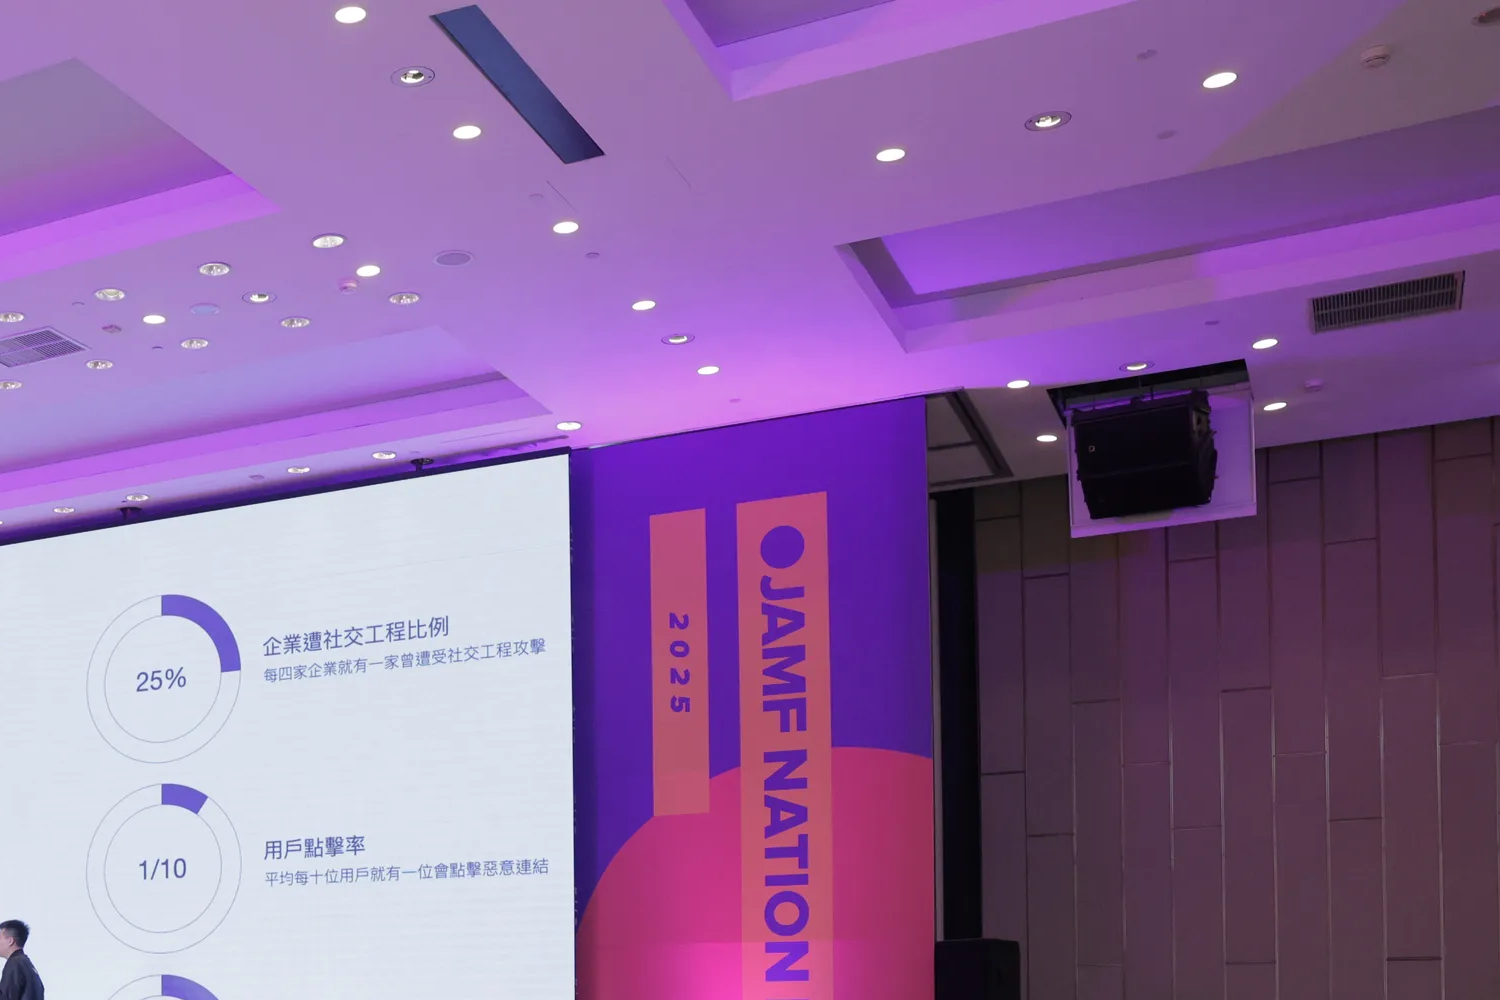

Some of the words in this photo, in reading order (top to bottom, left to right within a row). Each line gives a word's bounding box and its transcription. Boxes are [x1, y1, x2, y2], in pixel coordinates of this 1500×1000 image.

[263, 615, 449, 657] 企業遭社交工程比例
[760, 574, 808, 733] JAMF
[135, 666, 188, 693] 25%
[263, 637, 546, 684] 每四家企業就有一家曾遭受社交工程攻擊
[669, 612, 691, 713] 2025
[263, 835, 366, 861] 用戶點擊率
[763, 749, 810, 982] NATION
[138, 857, 188, 882] 1/10
[264, 858, 550, 887] 平均每十位用戶就有一位會點擊惡意連結
